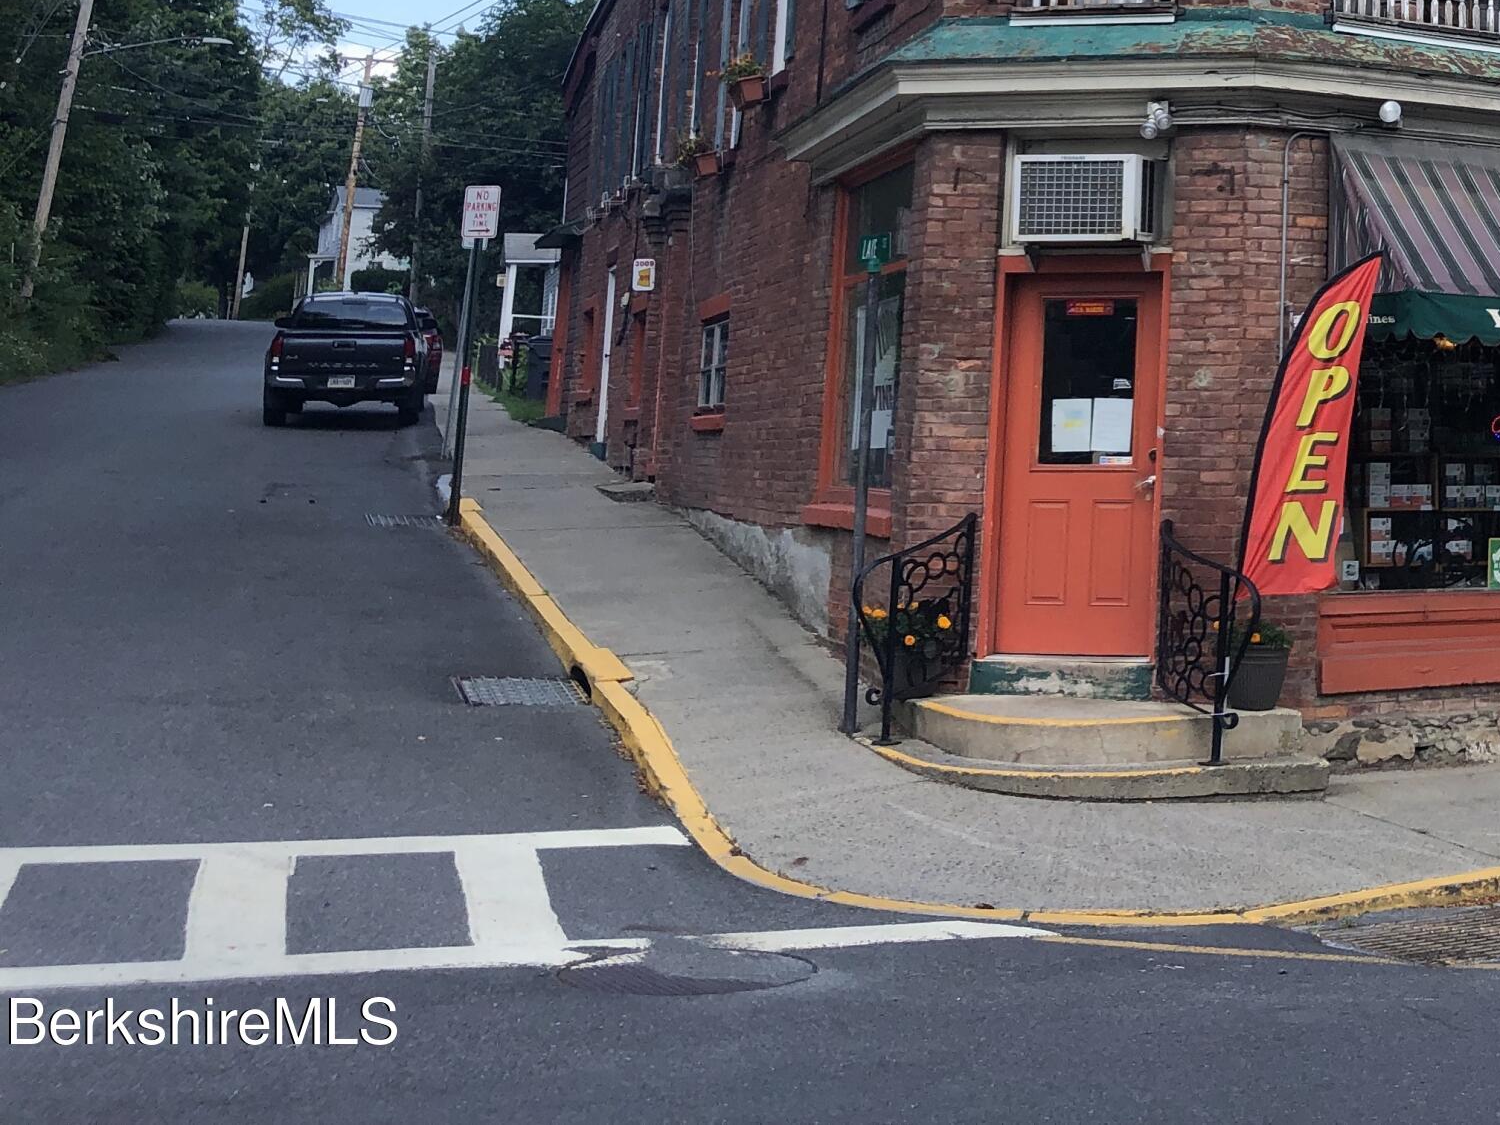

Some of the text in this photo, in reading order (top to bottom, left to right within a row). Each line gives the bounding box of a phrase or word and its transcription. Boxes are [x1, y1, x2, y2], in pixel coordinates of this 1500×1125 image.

[476, 191, 489, 200] NO
[465, 203, 497, 211] PARKING
[1366, 313, 1396, 325] ines
[1268, 300, 1362, 563] OPEN
